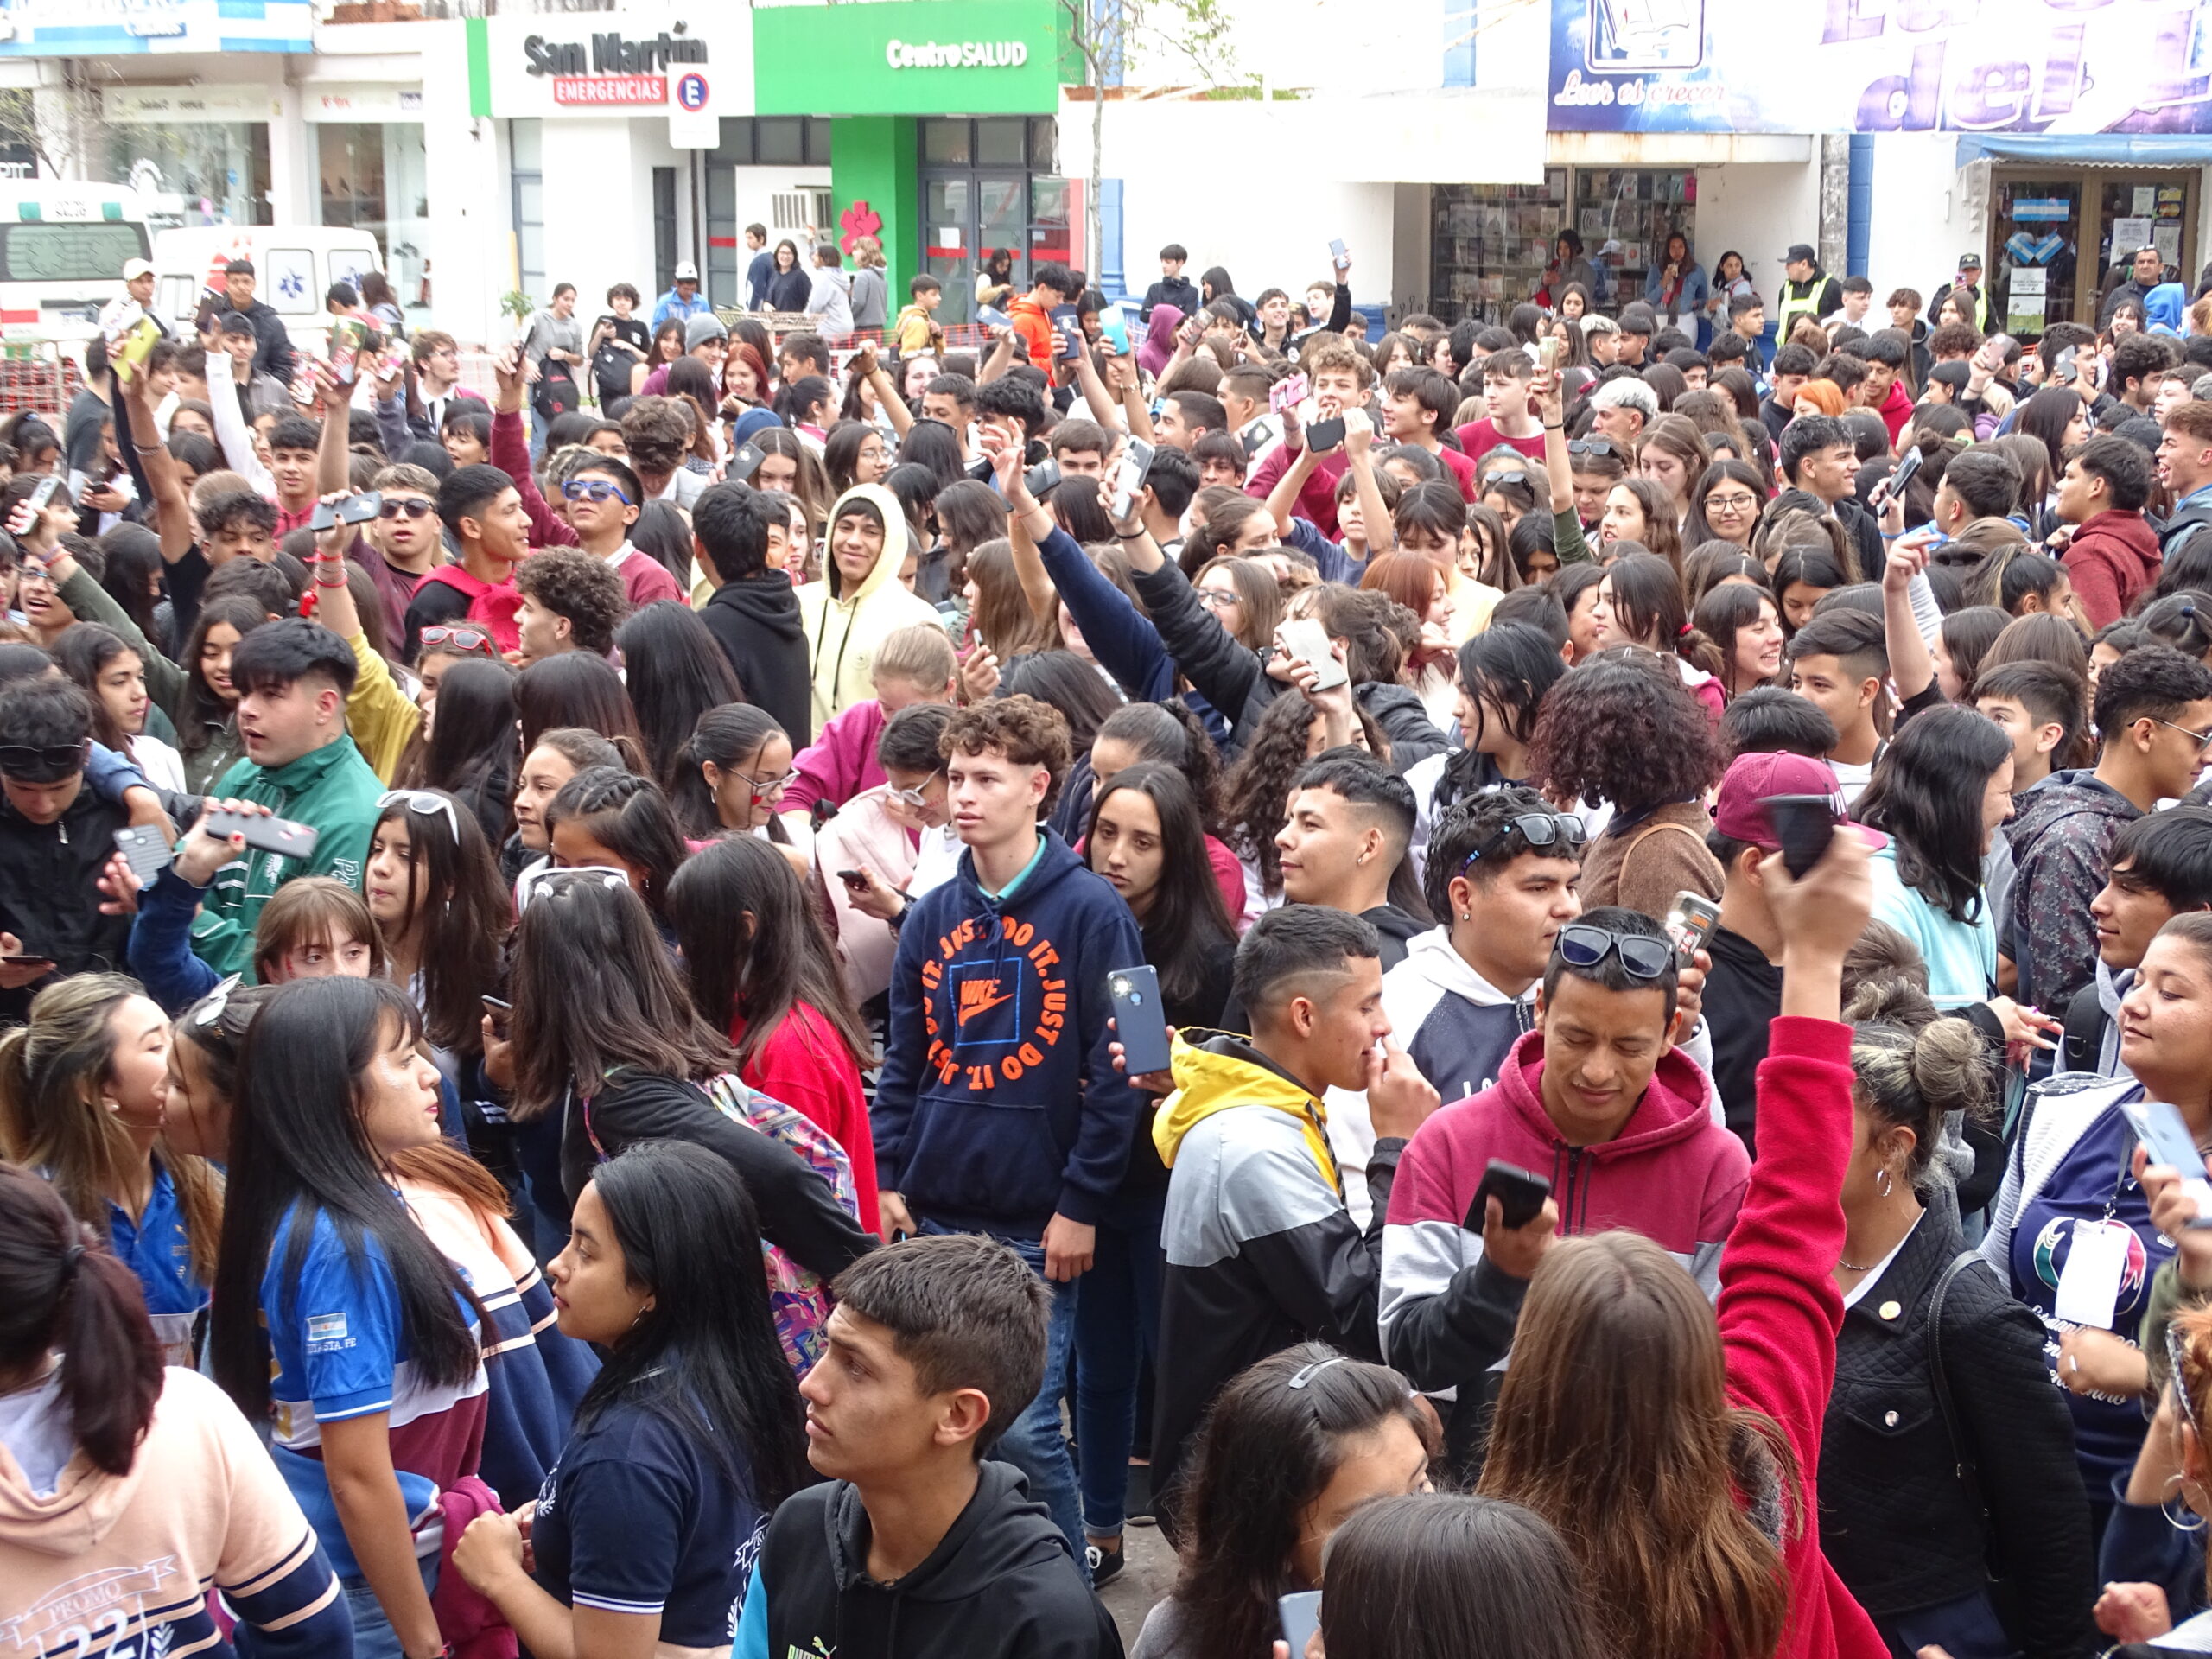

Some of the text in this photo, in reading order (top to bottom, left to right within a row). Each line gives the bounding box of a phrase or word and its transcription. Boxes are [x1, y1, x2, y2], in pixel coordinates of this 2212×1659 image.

[524, 35, 588, 77] San
[886, 39, 1027, 68] CentroSALUD
[556, 79, 661, 101] EMERGENCIAS
[685, 79, 700, 105] E
[1555, 69, 1726, 105] Leer es crecer
[1855, 22, 2086, 132] del
[938, 918, 987, 960] JUS
[1001, 916, 1034, 946] DO
[960, 979, 1001, 1006] NIKE
[1035, 979, 1067, 1046] JUST
[965, 1064, 995, 1090] IT.
[1001, 1042, 1045, 1080] DO
[48, 1580, 123, 1624] PROMO
[56, 1609, 137, 1659] 22
